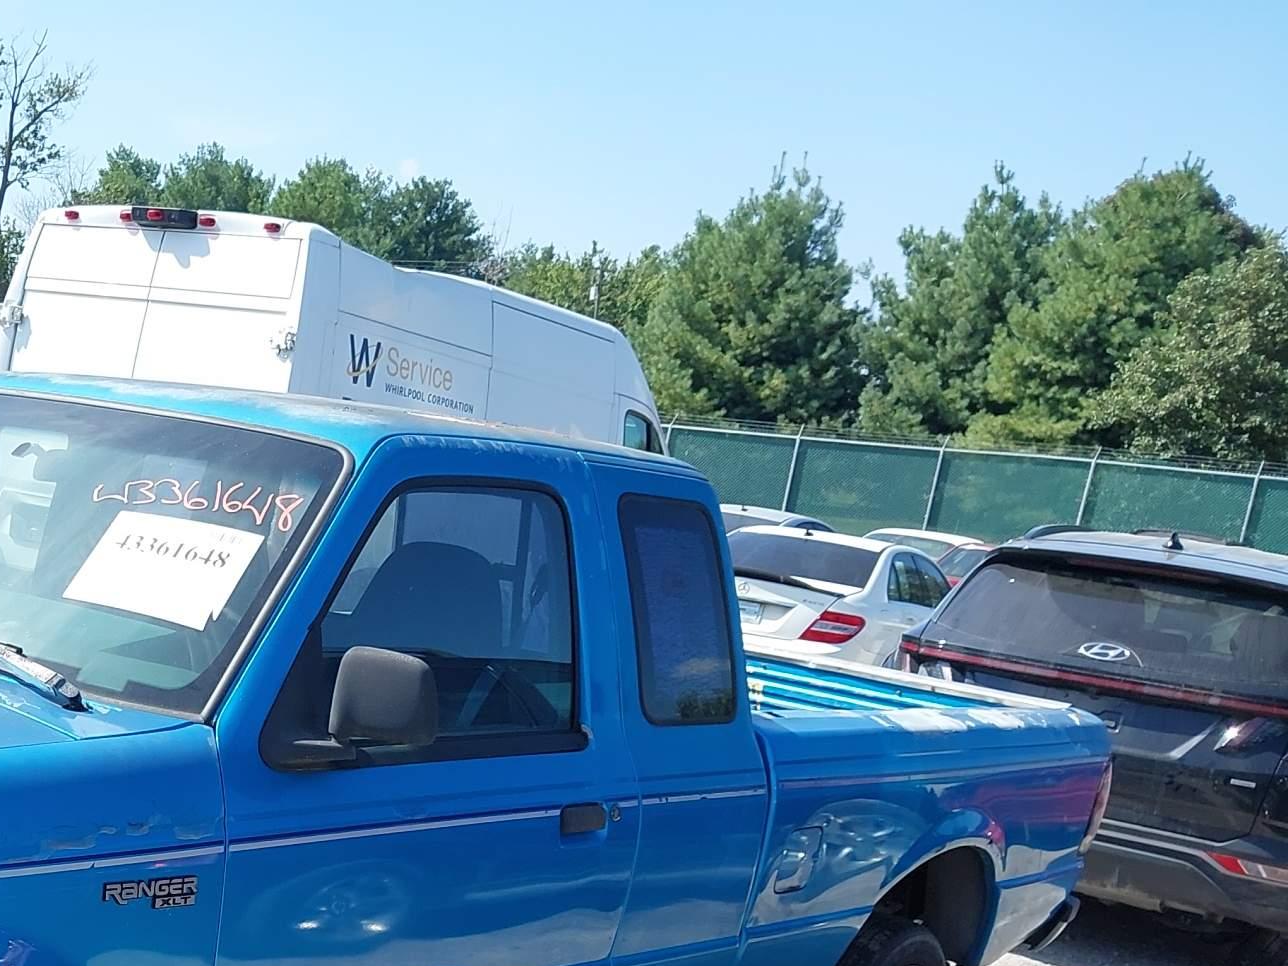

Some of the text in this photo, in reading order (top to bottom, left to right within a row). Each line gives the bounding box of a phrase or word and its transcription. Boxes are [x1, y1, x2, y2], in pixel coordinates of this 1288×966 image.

[386, 346, 453, 391] Service
[385, 383, 474, 415] WHIRLPOOL CORPORATION
[92, 478, 304, 531] 43361648
[115, 533, 231, 569] 43361648
[158, 896, 192, 907] XLT
